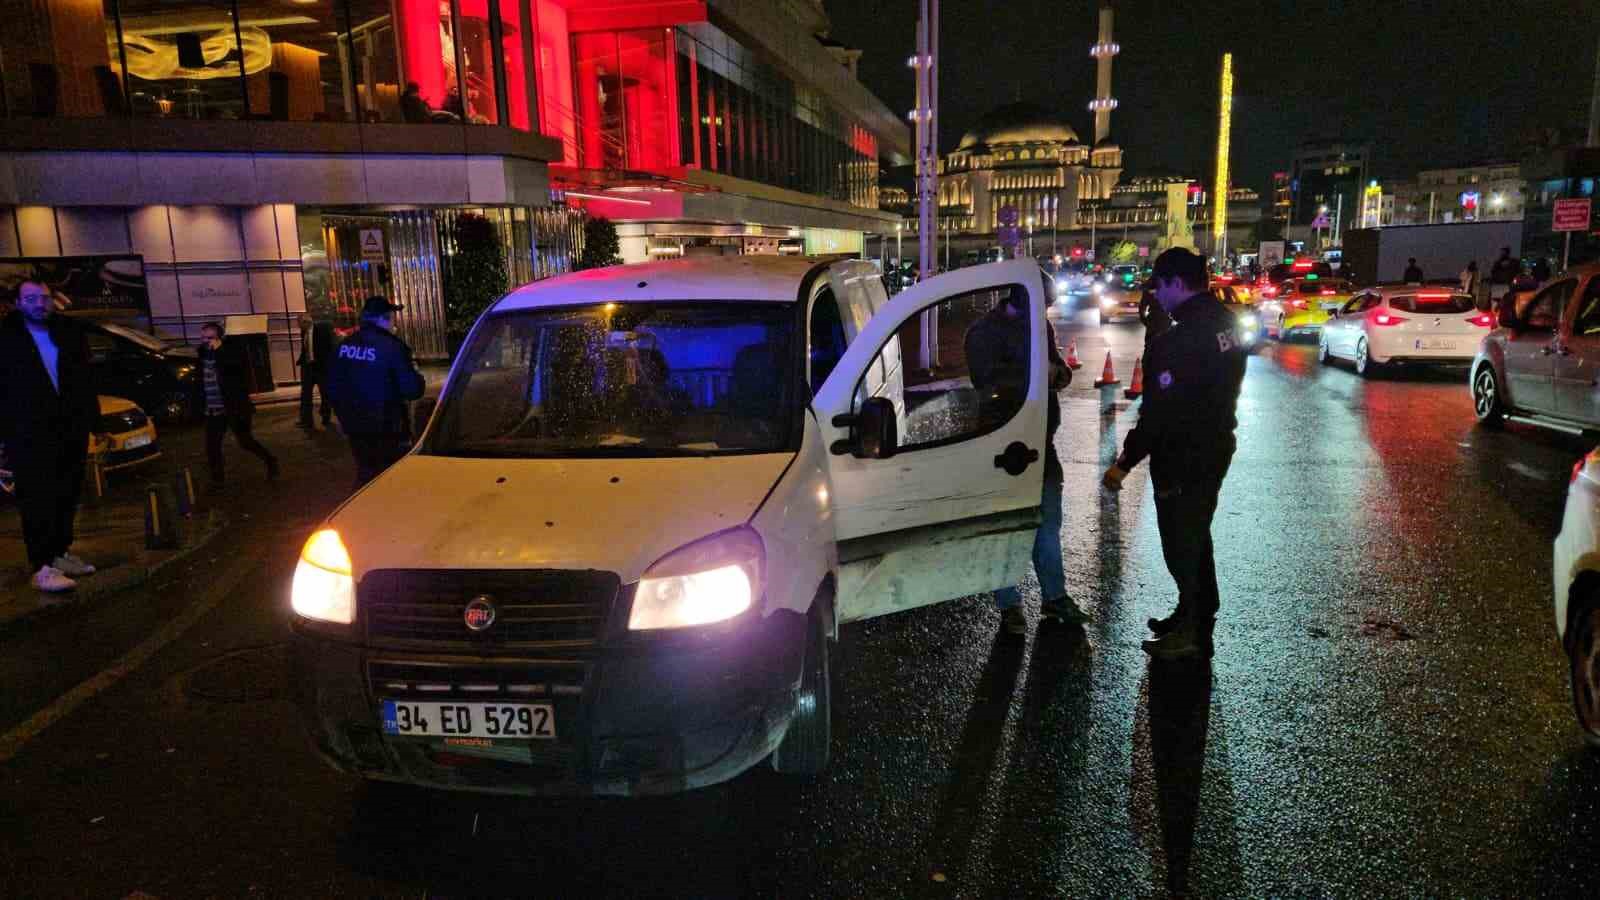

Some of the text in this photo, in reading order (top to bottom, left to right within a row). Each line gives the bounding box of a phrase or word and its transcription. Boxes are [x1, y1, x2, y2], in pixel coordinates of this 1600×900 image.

[397, 705, 553, 737] 34 ED 5292
